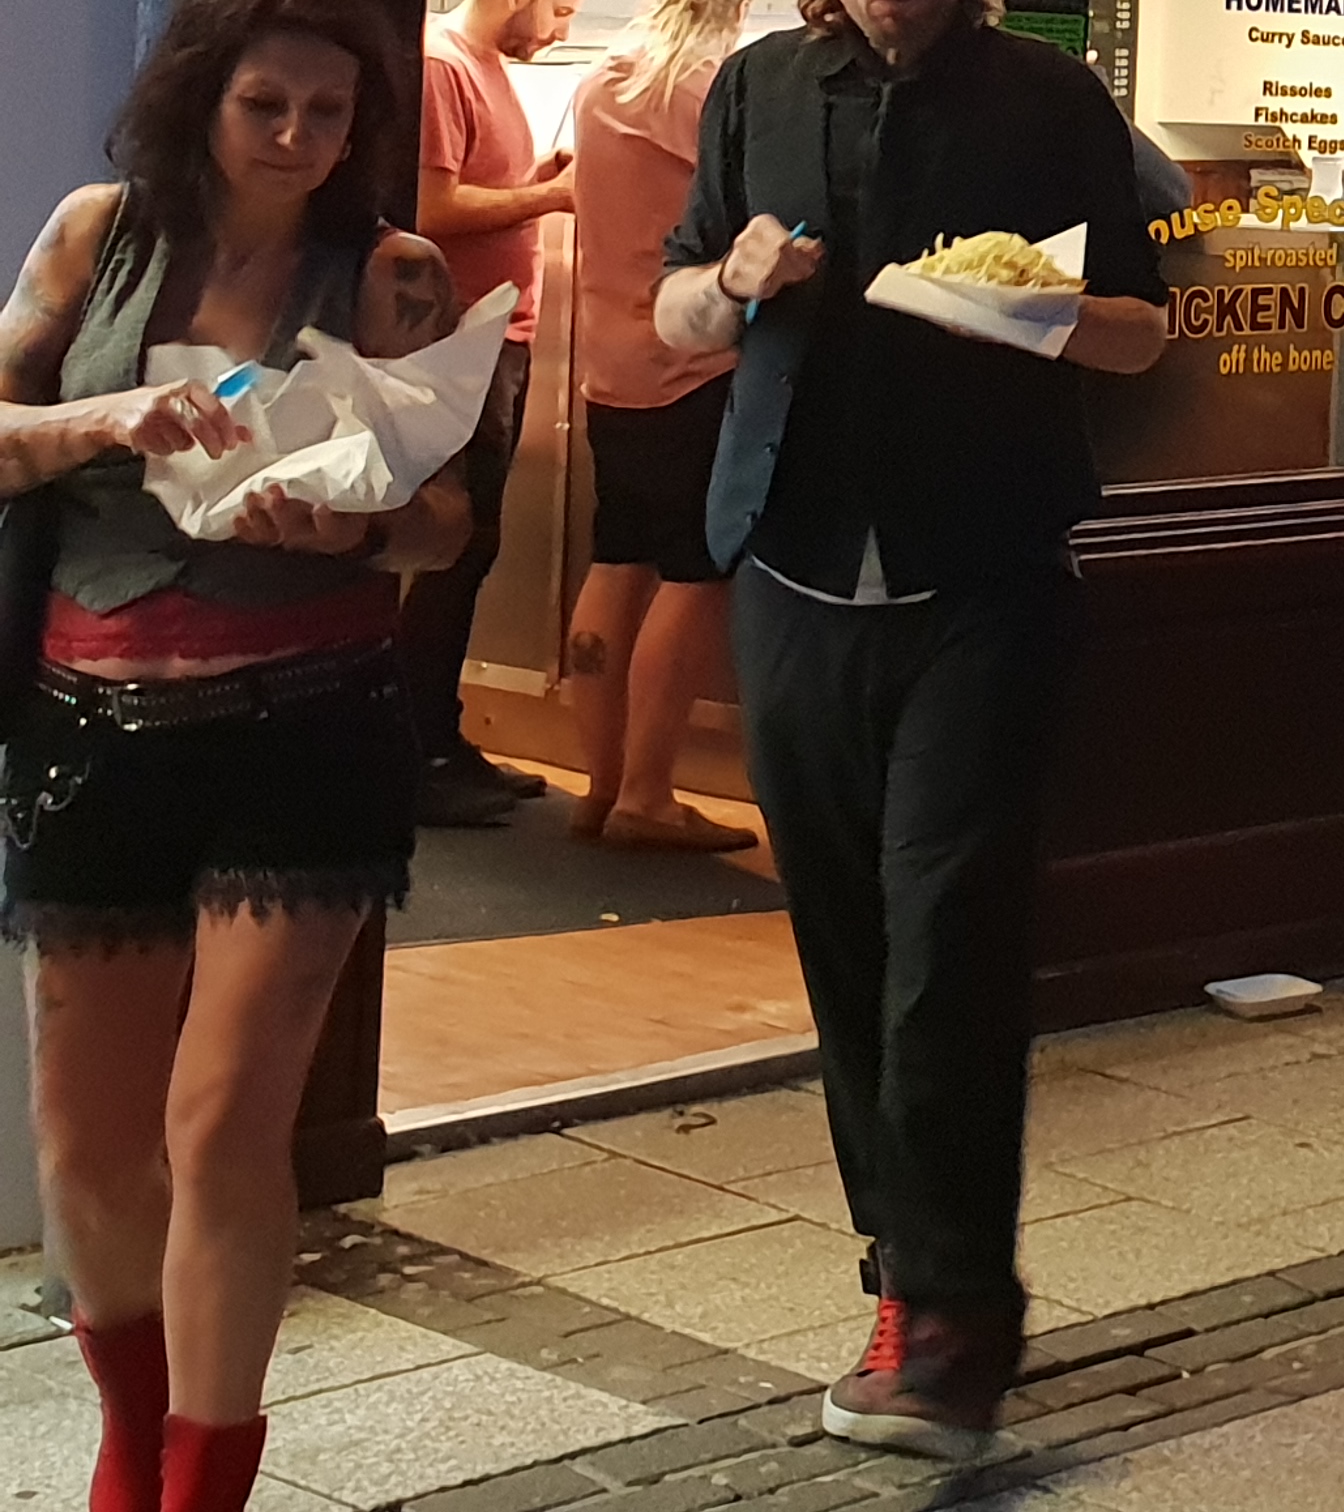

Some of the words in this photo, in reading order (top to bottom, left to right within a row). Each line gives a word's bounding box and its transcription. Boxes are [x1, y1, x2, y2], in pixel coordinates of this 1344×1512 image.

[1248, 26, 1296, 49] Curry
[1262, 80, 1333, 99] Rissoles
[1254, 106, 1339, 125] Fishcakes
[1243, 133, 1302, 151] Scotch
[1147, 197, 1243, 246] ouse
[1166, 281, 1309, 338] ICKEN
[1219, 343, 1248, 376] off
[1252, 345, 1283, 373] the
[1287, 342, 1334, 372] bone
